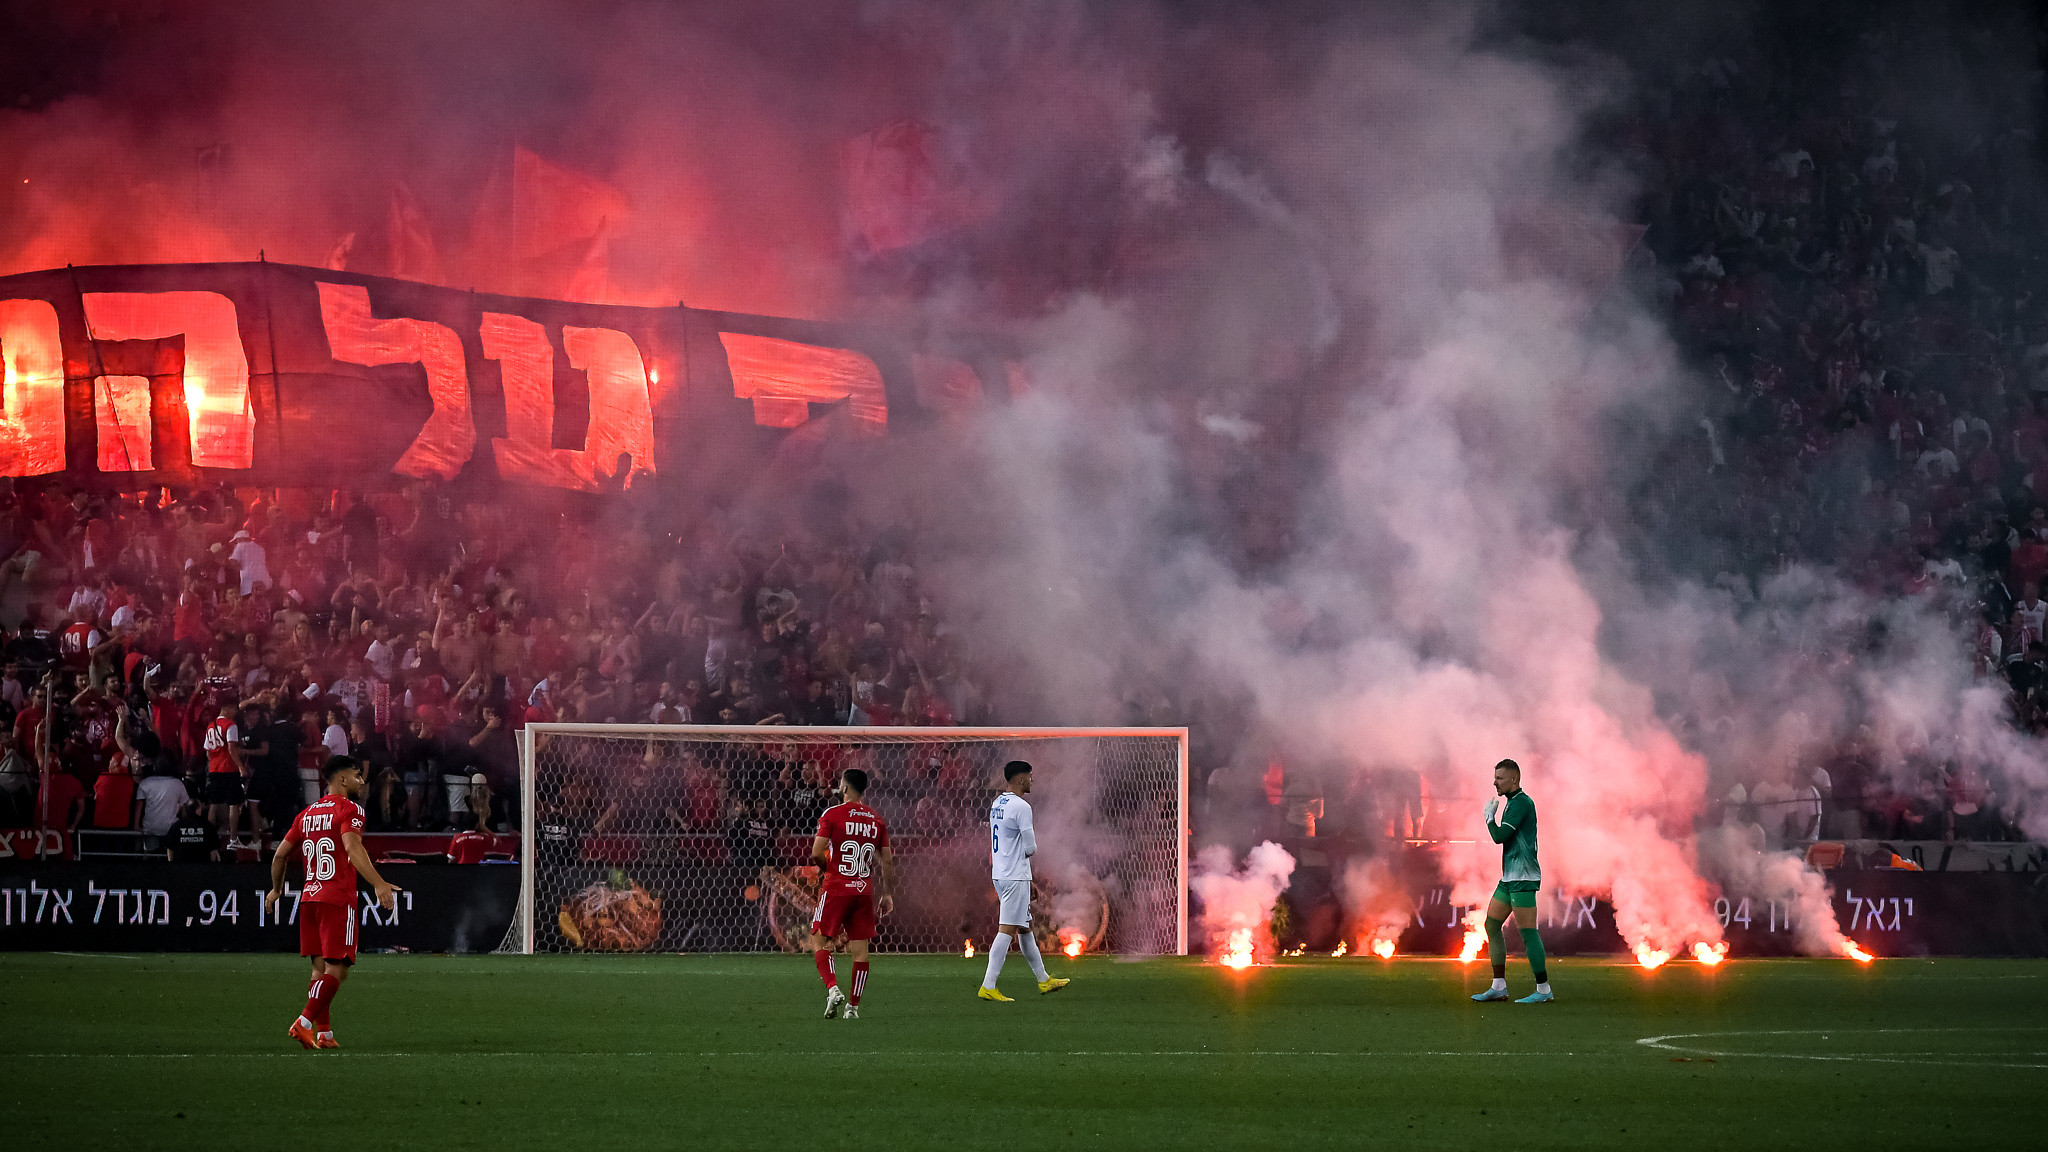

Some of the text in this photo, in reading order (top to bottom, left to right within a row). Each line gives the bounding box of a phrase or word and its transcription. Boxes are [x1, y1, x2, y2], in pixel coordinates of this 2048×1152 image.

[302, 836, 336, 881] 26
[838, 840, 876, 878] 30
[992, 823, 1000, 853] 6
[1, 879, 74, 926] אלון
[88, 879, 170, 925] מגדל
[255, 881, 302, 928] לון
[1846, 888, 1914, 932] יגאל
